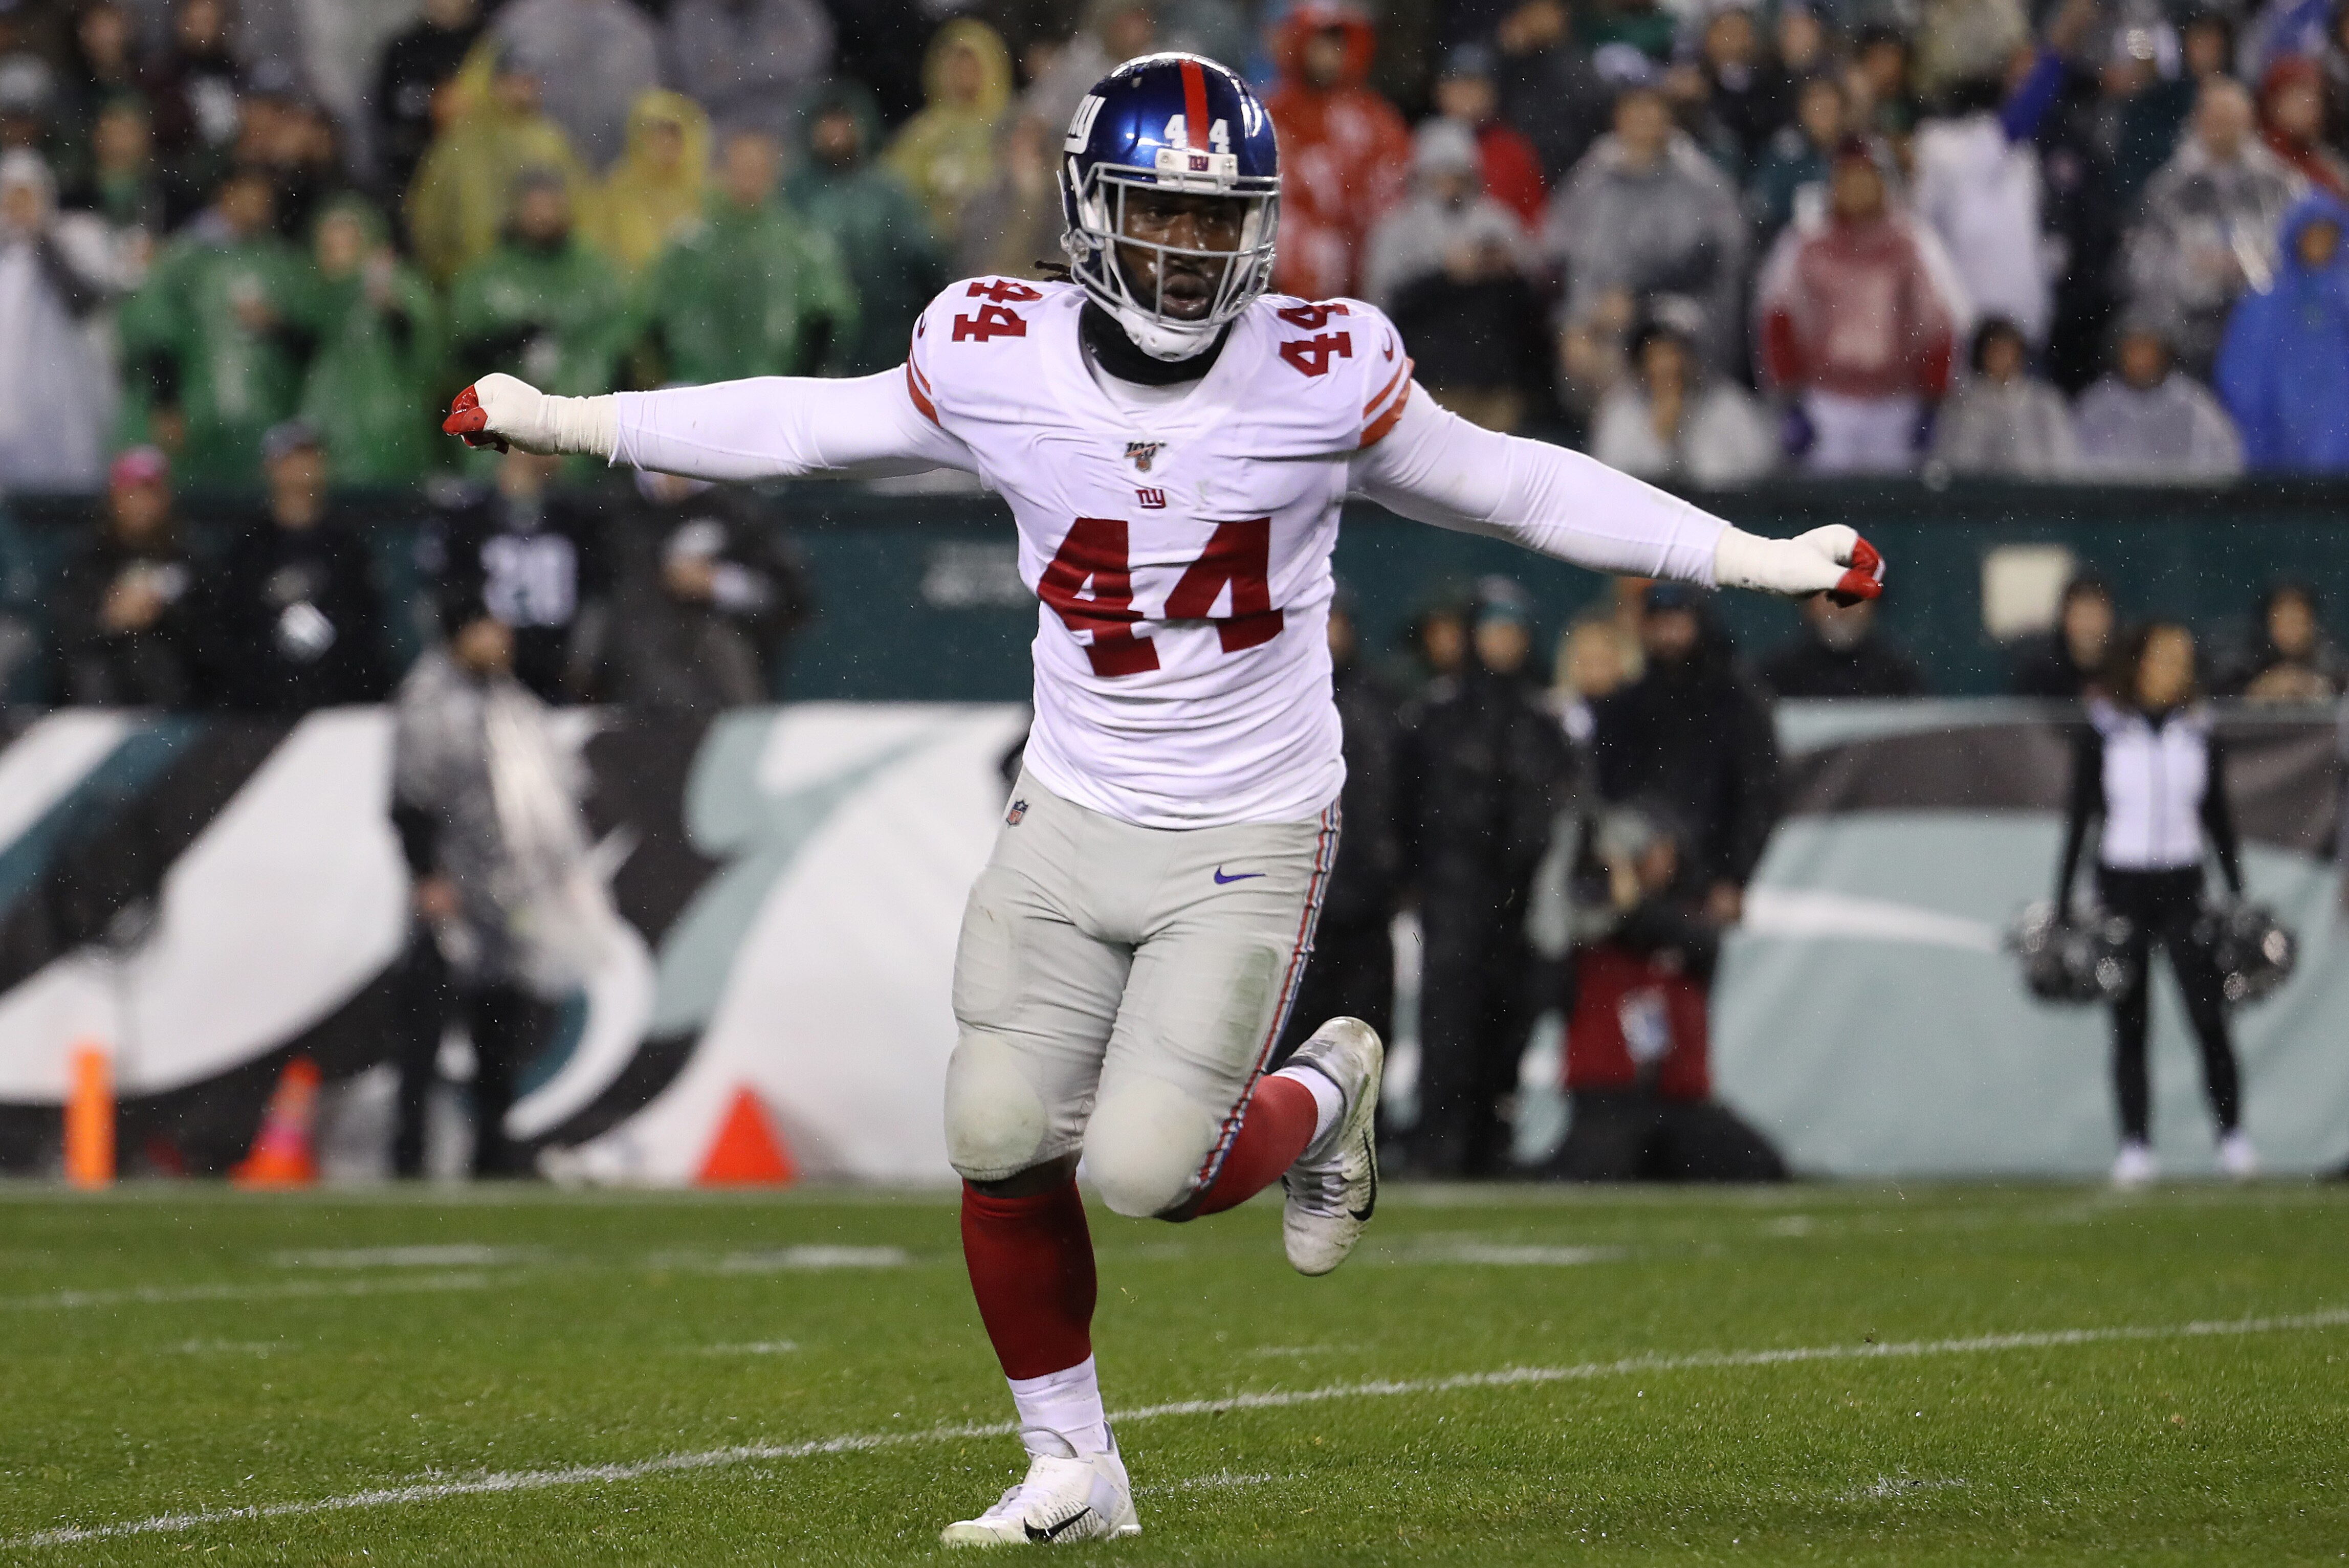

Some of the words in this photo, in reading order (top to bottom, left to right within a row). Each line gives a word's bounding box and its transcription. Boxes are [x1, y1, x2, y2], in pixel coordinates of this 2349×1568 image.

[952, 279, 1043, 342] 44
[1277, 303, 1352, 378] 44
[1037, 517, 1284, 677] 44
